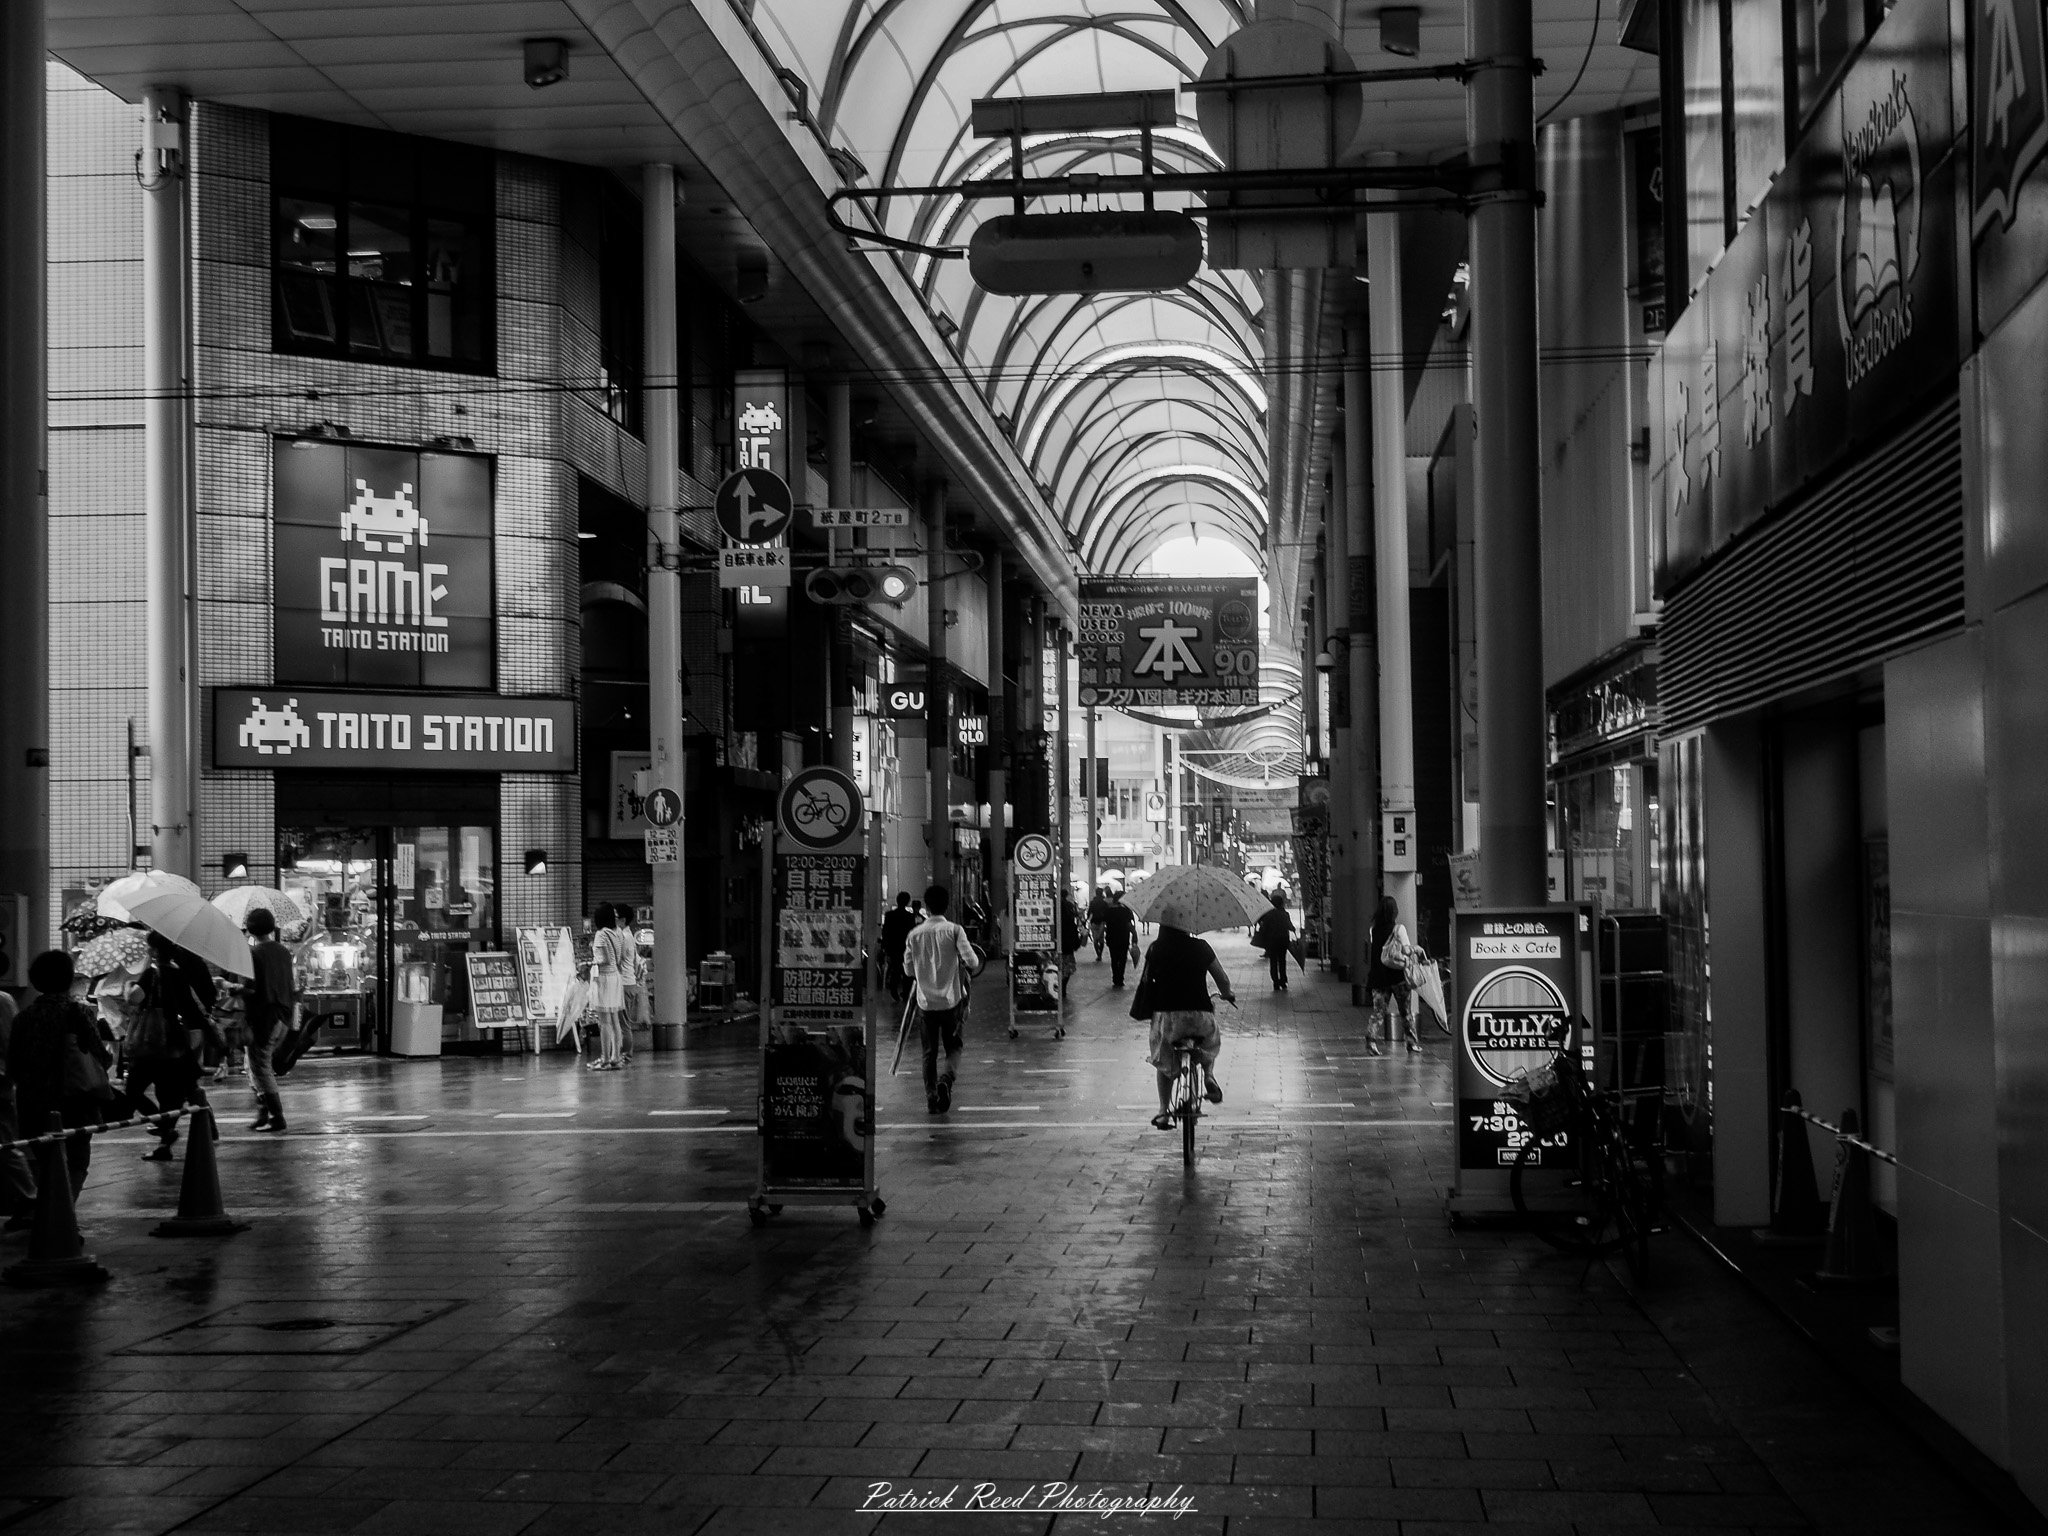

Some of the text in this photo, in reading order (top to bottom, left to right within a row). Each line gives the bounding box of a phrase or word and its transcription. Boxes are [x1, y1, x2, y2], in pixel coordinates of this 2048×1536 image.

[819, 510, 902, 525] 紙屋町2丁目
[724, 553, 784, 568] 自転車を除く
[320, 557, 449, 627] GAME
[1080, 618, 1118, 631] USED
[321, 628, 449, 653] TAITO STATION
[1080, 631, 1125, 643] BOOKS
[1134, 619, 1203, 682] 本
[1214, 649, 1257, 676] 90
[890, 691, 925, 710] GU
[317, 712, 553, 753] TAITO STATION
[958, 717, 982, 731] UNI
[959, 730, 985, 745] QLO
[787, 869, 853, 889] 自転車
[785, 890, 852, 910] 通行止
[1475, 942, 1557, 954] Book & Cafe
[783, 970, 853, 988] 防犯カメラ
[783, 988, 854, 1005] 設置商店街
[1488, 1037, 1546, 1048] COFFEE
